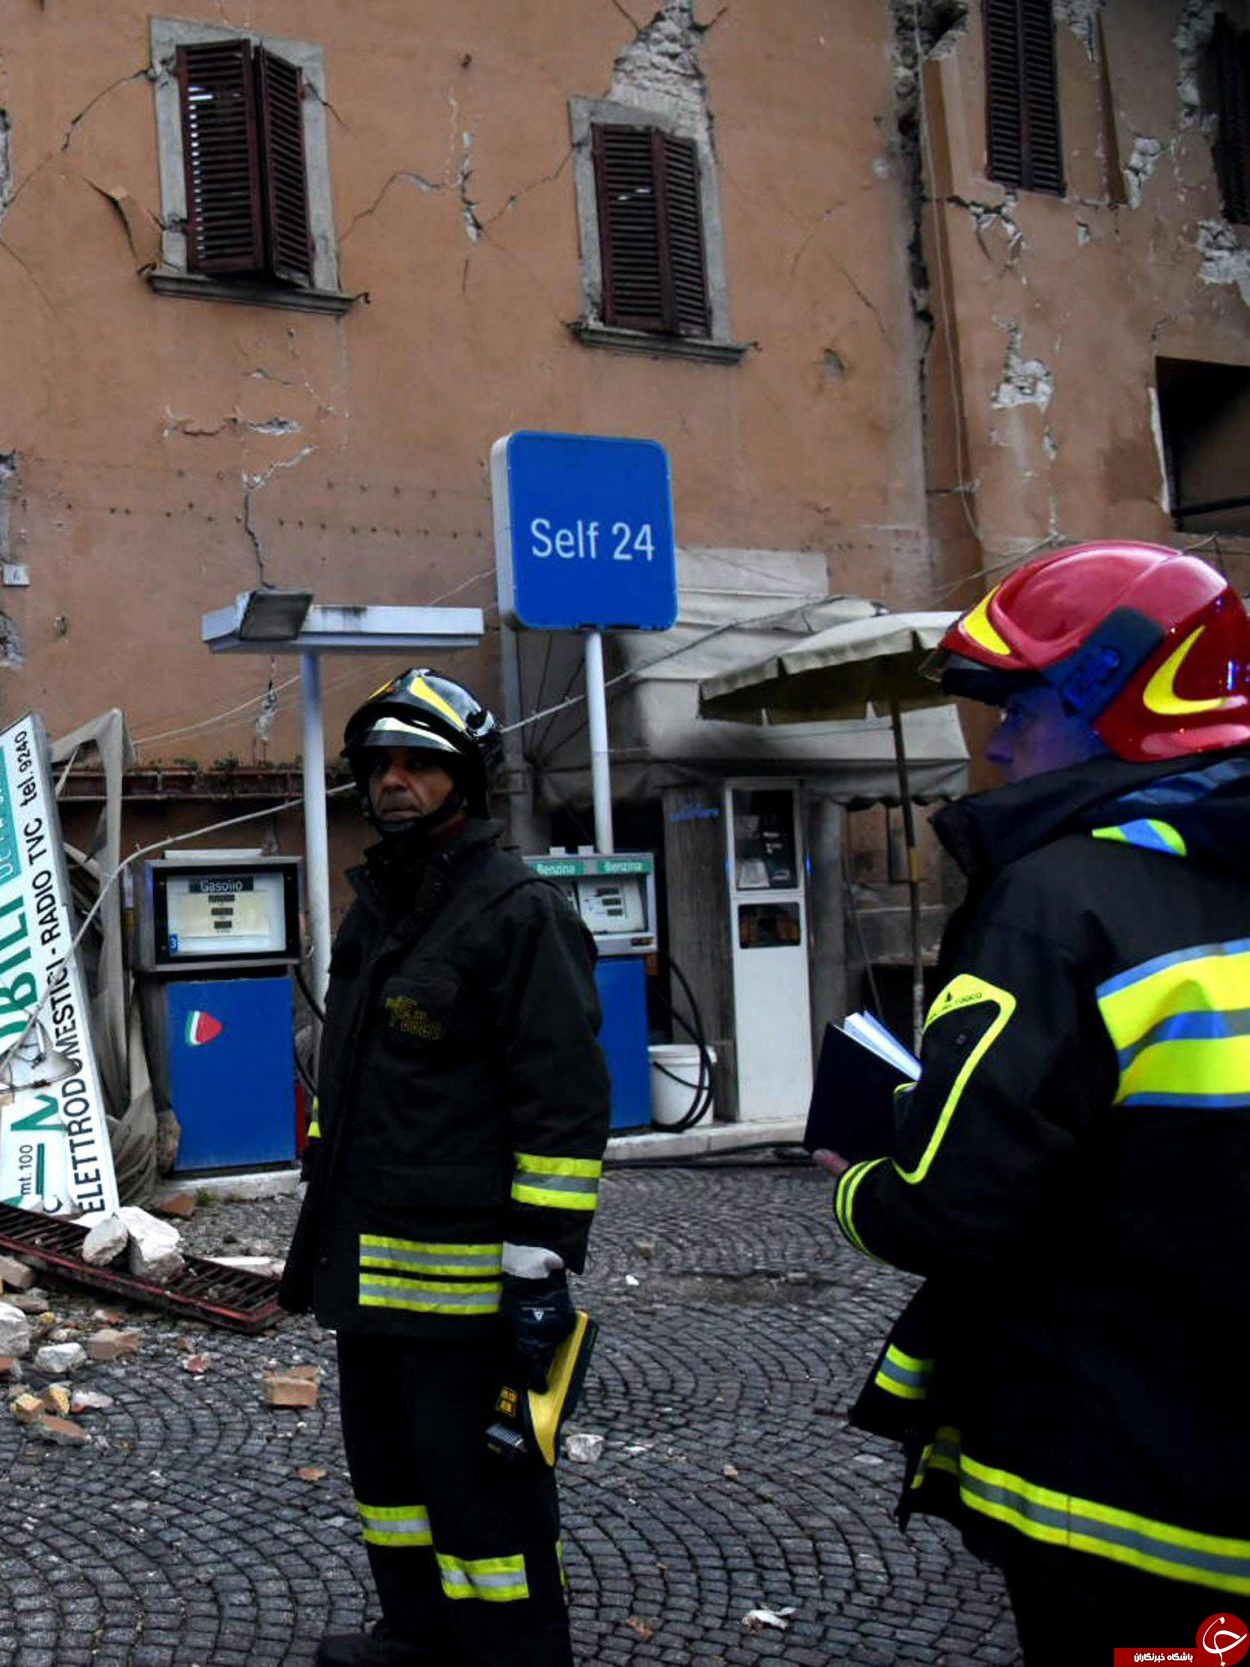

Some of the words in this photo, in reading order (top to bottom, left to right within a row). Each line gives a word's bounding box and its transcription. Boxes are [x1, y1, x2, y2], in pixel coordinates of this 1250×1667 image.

[530, 517, 599, 559] Self
[611, 521, 655, 561] 24
[23, 817, 48, 866] TVC
[537, 863, 575, 875] Benzina
[604, 861, 642, 873] Benzina
[200, 880, 243, 892] Gasolio
[31, 870, 62, 946] RADIO
[18, 1144, 33, 1171] 100
